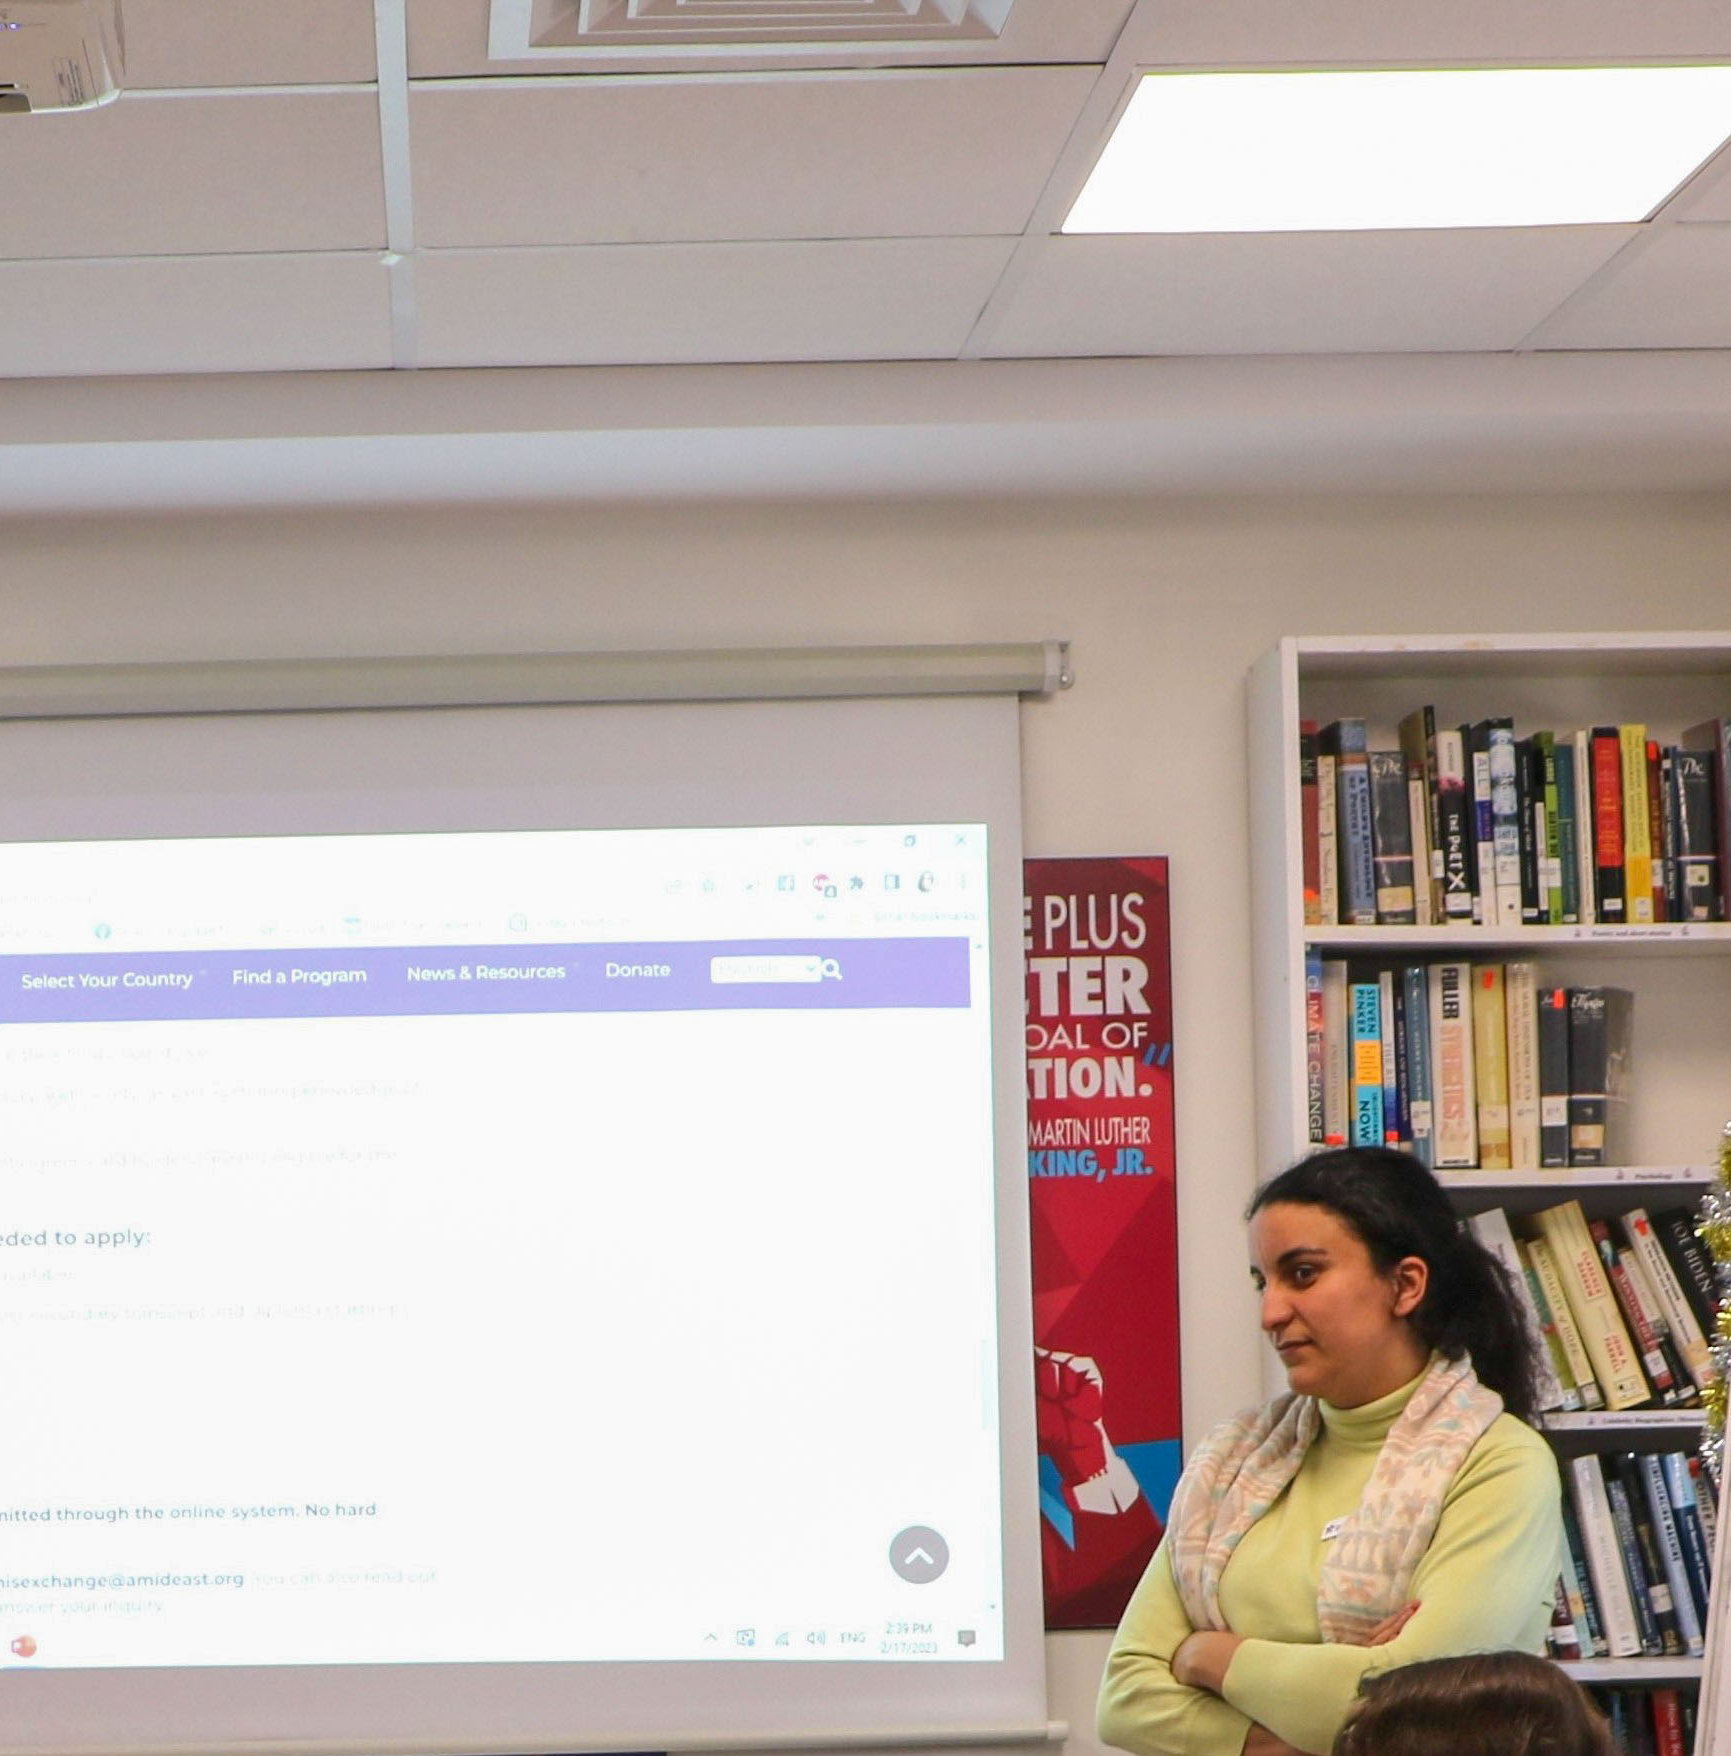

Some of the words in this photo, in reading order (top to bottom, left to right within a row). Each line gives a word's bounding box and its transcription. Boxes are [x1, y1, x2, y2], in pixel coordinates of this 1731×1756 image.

[1447, 870, 1466, 891] X
[1044, 893, 1147, 951] PLUS
[22, 975, 74, 988] Select
[79, 974, 118, 987] Your
[123, 972, 193, 989] Country
[233, 969, 271, 984] Find
[276, 972, 286, 984] a
[292, 969, 367, 986] Program
[408, 967, 455, 981] News
[459, 966, 471, 980] &
[477, 965, 565, 979] Resources
[606, 963, 671, 977] Donate
[1024, 954, 1152, 1018] TER
[1356, 989, 1366, 1034] PINKER
[1366, 989, 1377, 1034] STEVEN
[1442, 967, 1460, 1020] FULLER
[1101, 1021, 1148, 1050] OF
[1307, 975, 1323, 1063] CLIMATE
[1308, 1064, 1323, 1142] CHANGE
[1359, 1100, 1372, 1143] NOW
[1028, 1117, 1090, 1147] MARTIN
[1094, 1116, 1151, 1146] LUTHER
[1028, 1150, 1106, 1183] KING,
[1112, 1149, 1153, 1176] JR.
[55, 1232, 76, 1245] to
[85, 1229, 149, 1248] apply:
[1672, 1221, 1686, 1245] JOE
[1684, 1248, 1712, 1294] BIDEN
[57, 1507, 128, 1522] through
[136, 1507, 164, 1519] the
[170, 1505, 225, 1518] online
[232, 1506, 298, 1520] system.
[306, 1505, 329, 1516] No
[336, 1504, 376, 1516] hard
[1652, 1466, 1671, 1521] INFLUENCING
[1666, 1521, 1681, 1561] MACHINE
